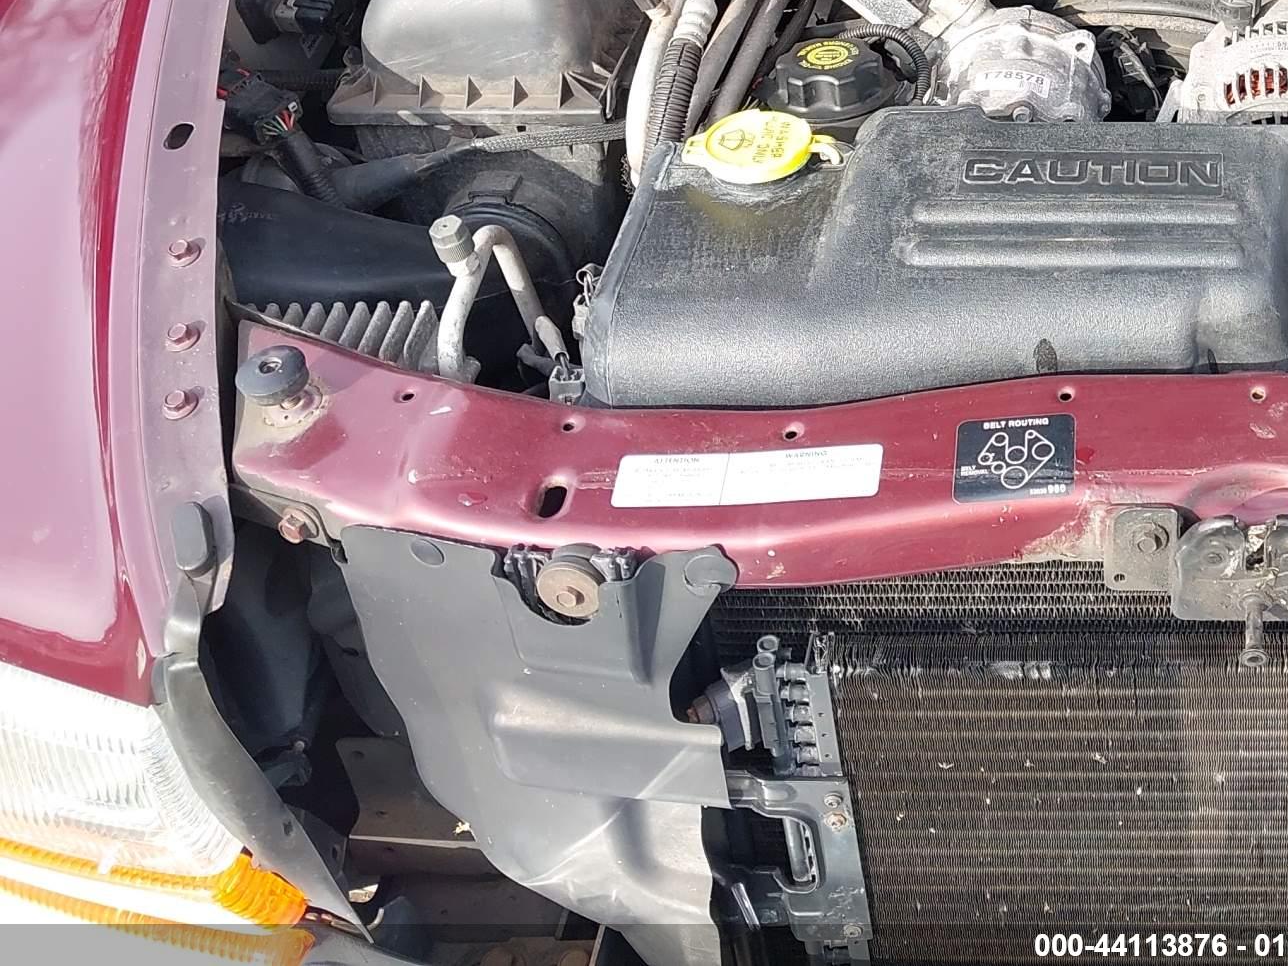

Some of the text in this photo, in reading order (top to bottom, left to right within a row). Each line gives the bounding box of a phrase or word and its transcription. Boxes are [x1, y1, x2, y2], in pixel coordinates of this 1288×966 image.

[962, 157, 1222, 187] CAUTION
[982, 417, 1050, 430] BELT ROUTING
